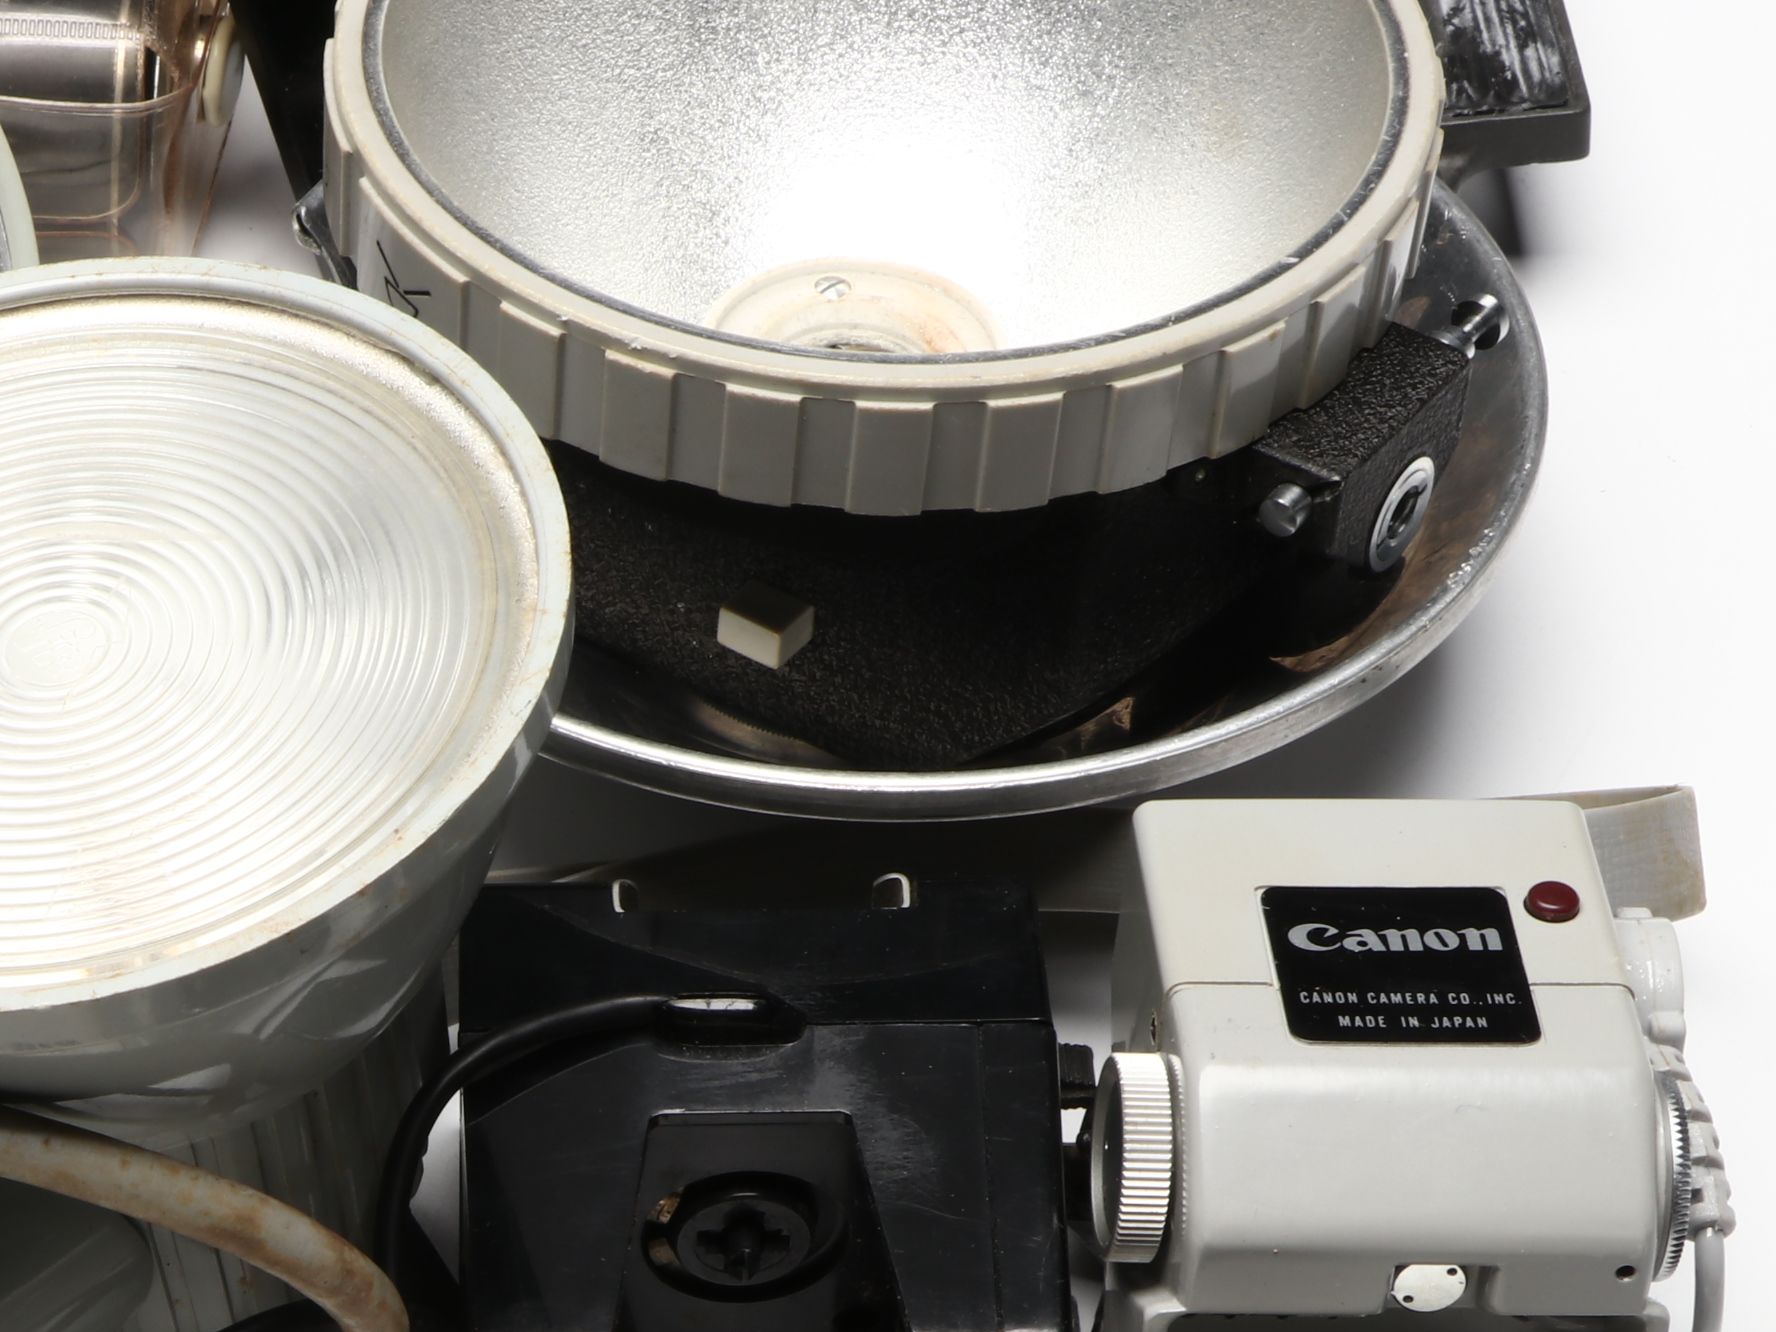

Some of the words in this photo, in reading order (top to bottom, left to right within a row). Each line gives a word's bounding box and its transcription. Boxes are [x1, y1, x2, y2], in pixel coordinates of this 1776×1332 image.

[1286, 923, 1504, 953] Canon
[1300, 991, 1359, 1004] CANON
[1367, 992, 1439, 1005] CAMERA
[1338, 1015, 1387, 1028] MADE
[1401, 1016, 1420, 1028] IN
[1431, 1016, 1488, 1028] JAPAN
